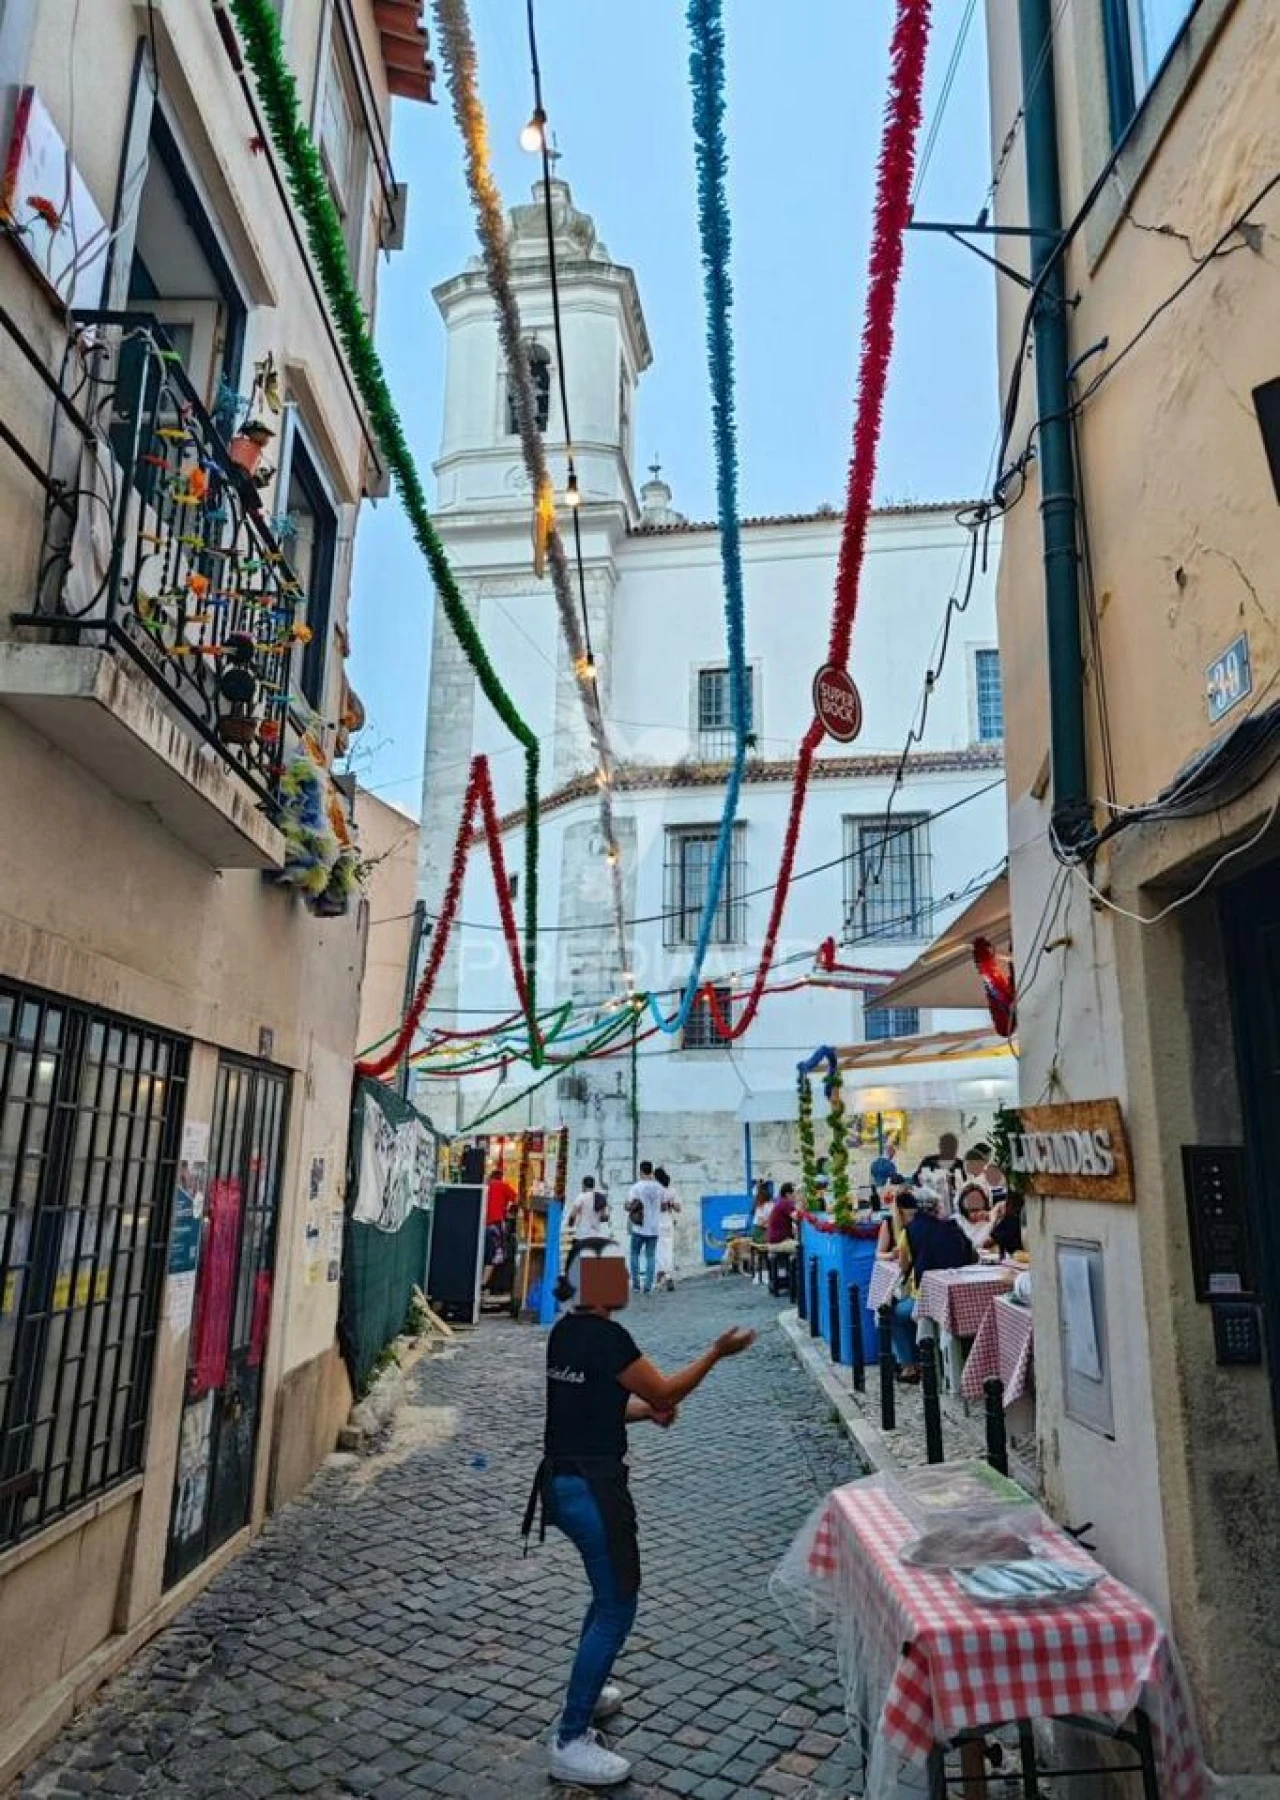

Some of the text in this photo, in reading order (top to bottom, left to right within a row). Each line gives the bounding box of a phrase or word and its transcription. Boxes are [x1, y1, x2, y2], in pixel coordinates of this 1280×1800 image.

[821, 682, 854, 709] SUPER
[1213, 650, 1240, 709] 39
[821, 697, 854, 724] BOCK
[1007, 1129, 1114, 1176] LUCINDAS
